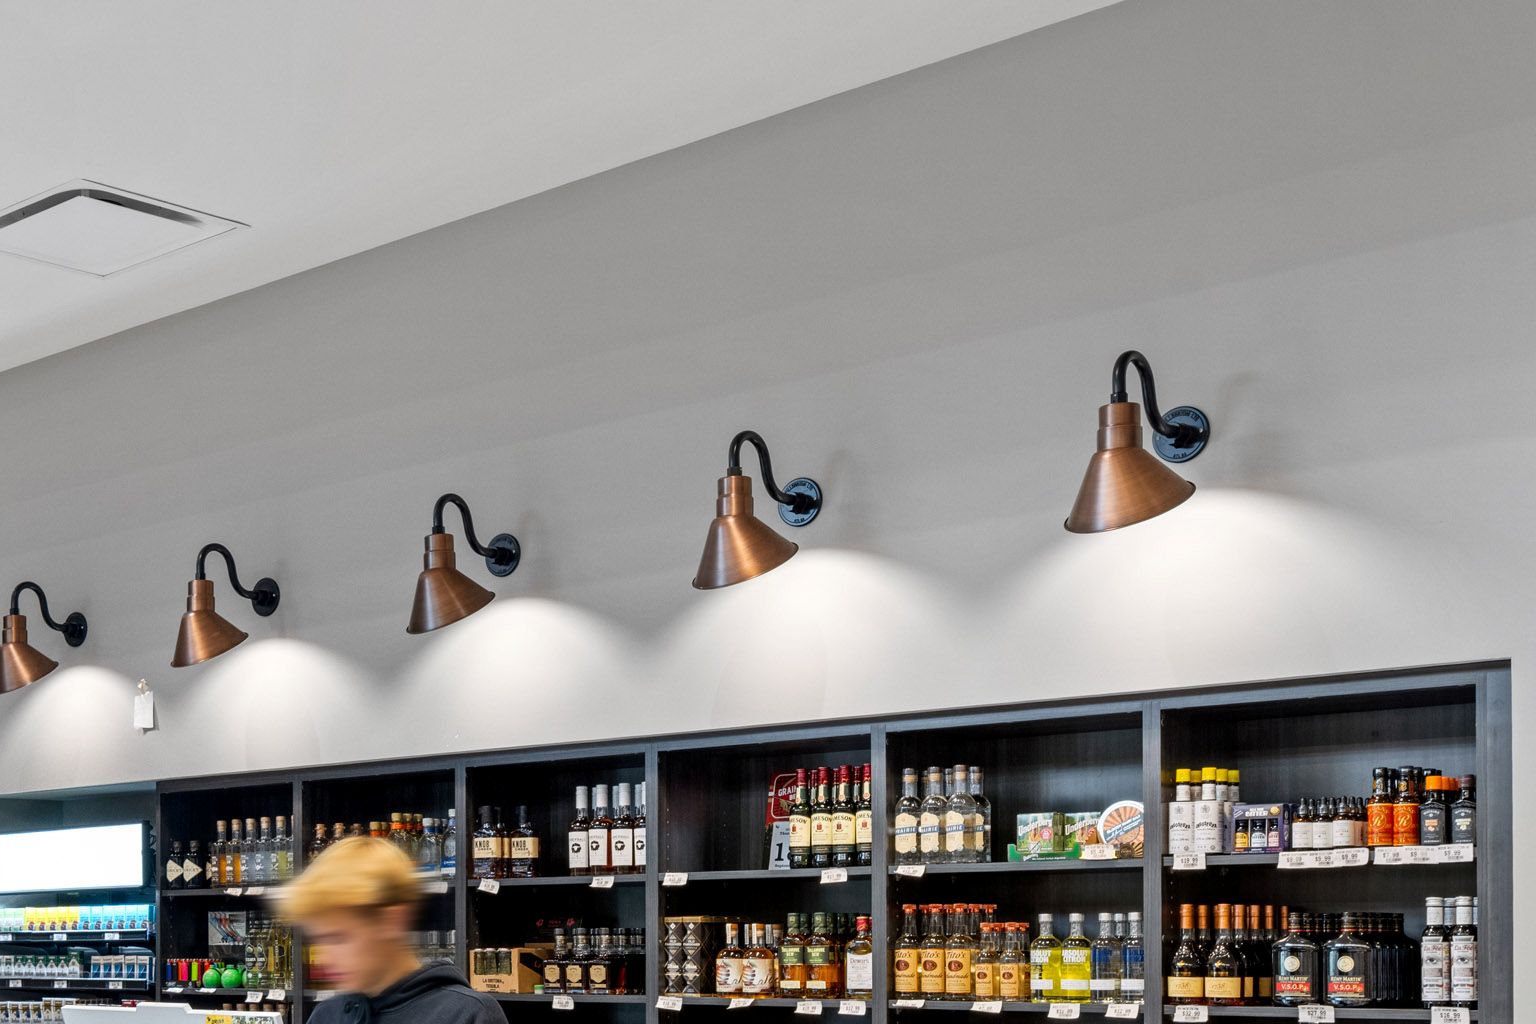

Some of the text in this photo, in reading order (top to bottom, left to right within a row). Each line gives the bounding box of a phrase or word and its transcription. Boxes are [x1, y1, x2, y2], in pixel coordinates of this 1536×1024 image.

[475, 840, 489, 848] KNOB
[512, 840, 526, 848] KNOB
[921, 951, 939, 959] Tito's
[946, 951, 966, 959] Tito's
